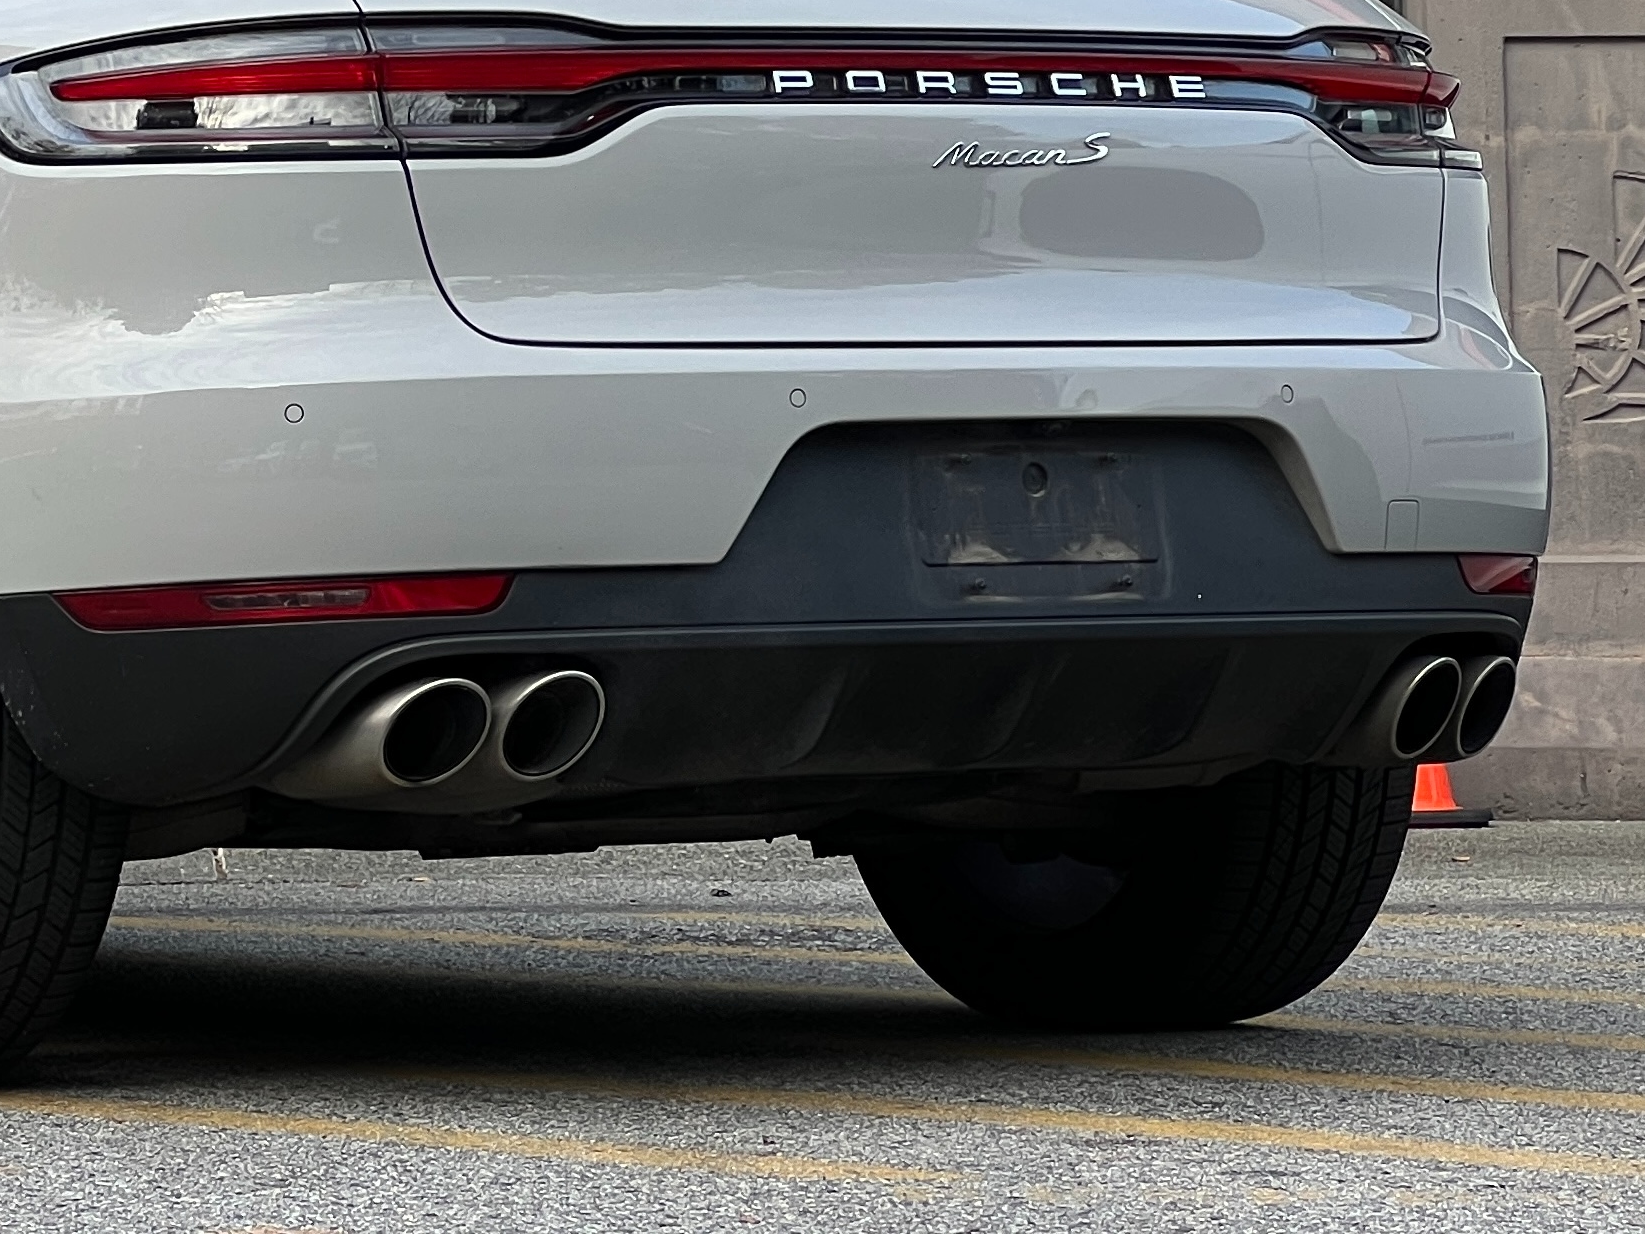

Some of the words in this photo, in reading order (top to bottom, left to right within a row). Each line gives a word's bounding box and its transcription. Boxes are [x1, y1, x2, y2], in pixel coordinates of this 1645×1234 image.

[772, 70, 1206, 98] PORSCHE
[931, 140, 1067, 168] Macan
[1063, 132, 1111, 165] S
